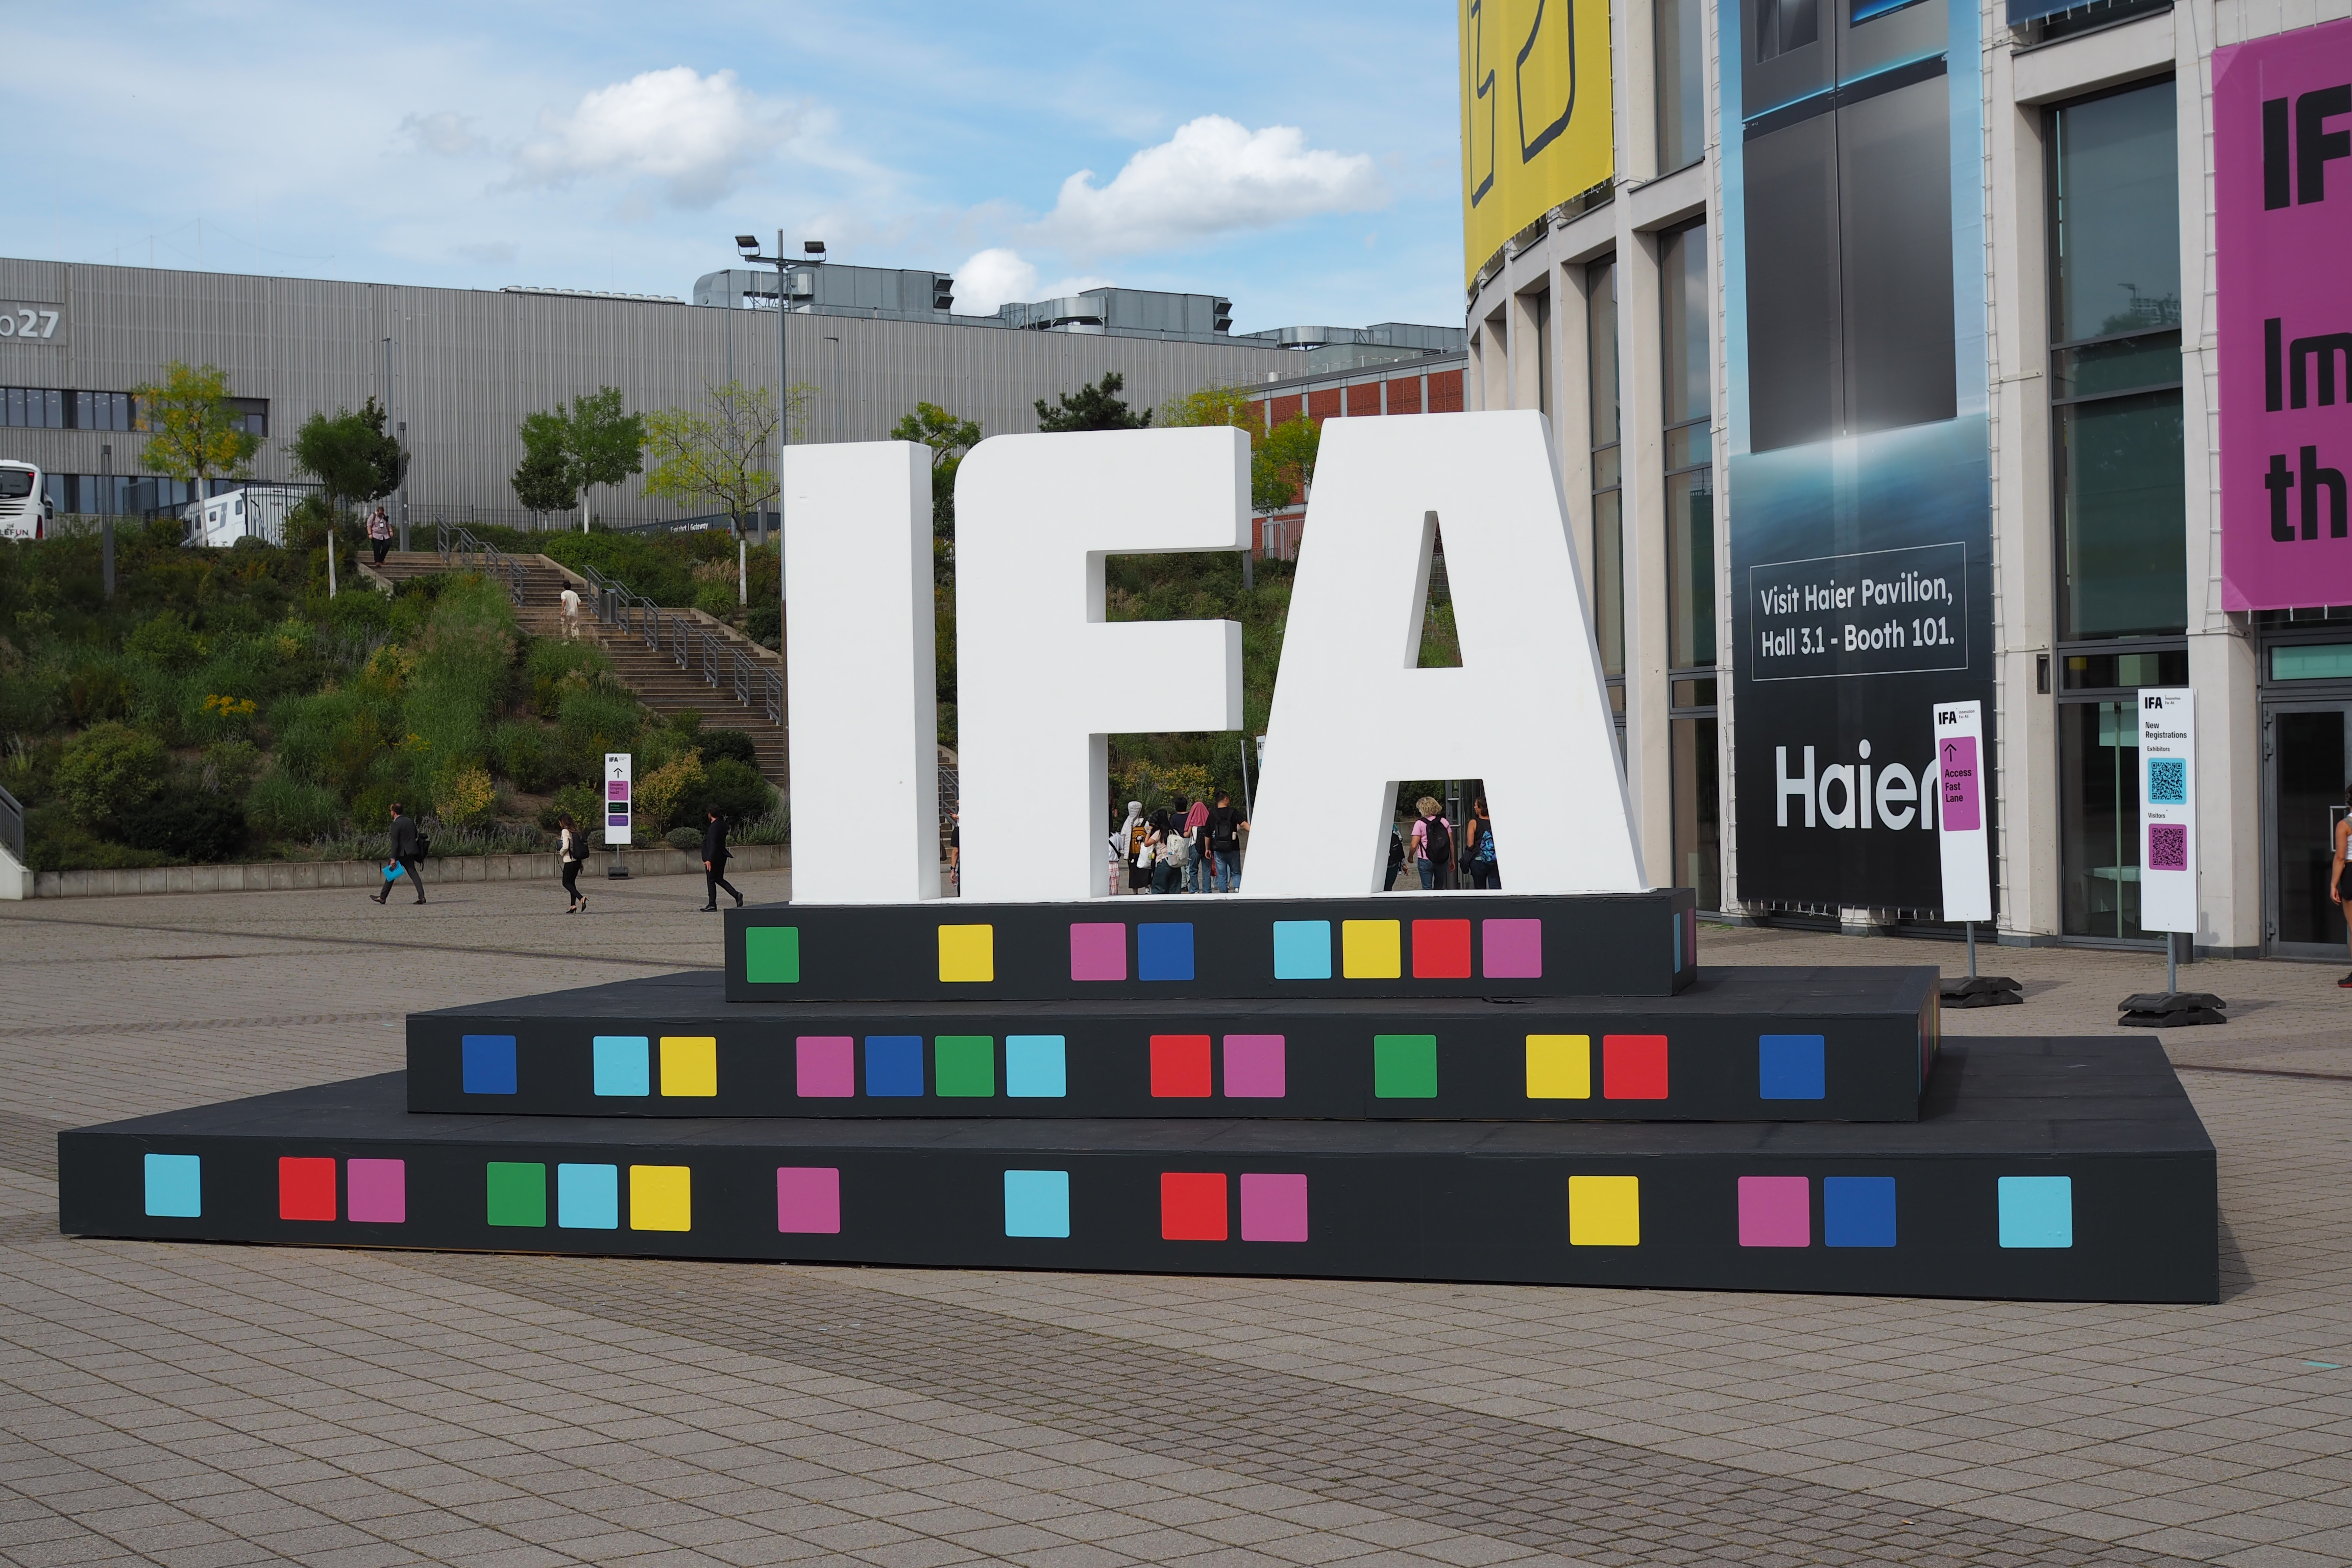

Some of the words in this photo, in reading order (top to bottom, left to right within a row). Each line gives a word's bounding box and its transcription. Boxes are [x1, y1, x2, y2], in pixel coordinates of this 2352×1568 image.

[2264, 445, 2348, 543] th
[1760, 585, 1799, 615] Visit
[1805, 579, 1855, 612] Haier
[1861, 571, 1953, 606] Pavilion,
[1762, 628, 1796, 657] Hall
[1801, 626, 1825, 654] 3.1
[1844, 619, 1905, 652] Booth
[1912, 616, 1954, 647] 101.
[783, 409, 1647, 903] IFA
[2145, 697, 2163, 709] IFA
[1939, 711, 1957, 725] IFA
[2145, 731, 2187, 740] Registrations
[1945, 769, 1972, 778] Access
[1776, 739, 1938, 831] Haier
[1945, 782, 1961, 791] Fast
[1946, 794, 1964, 803] Lane
